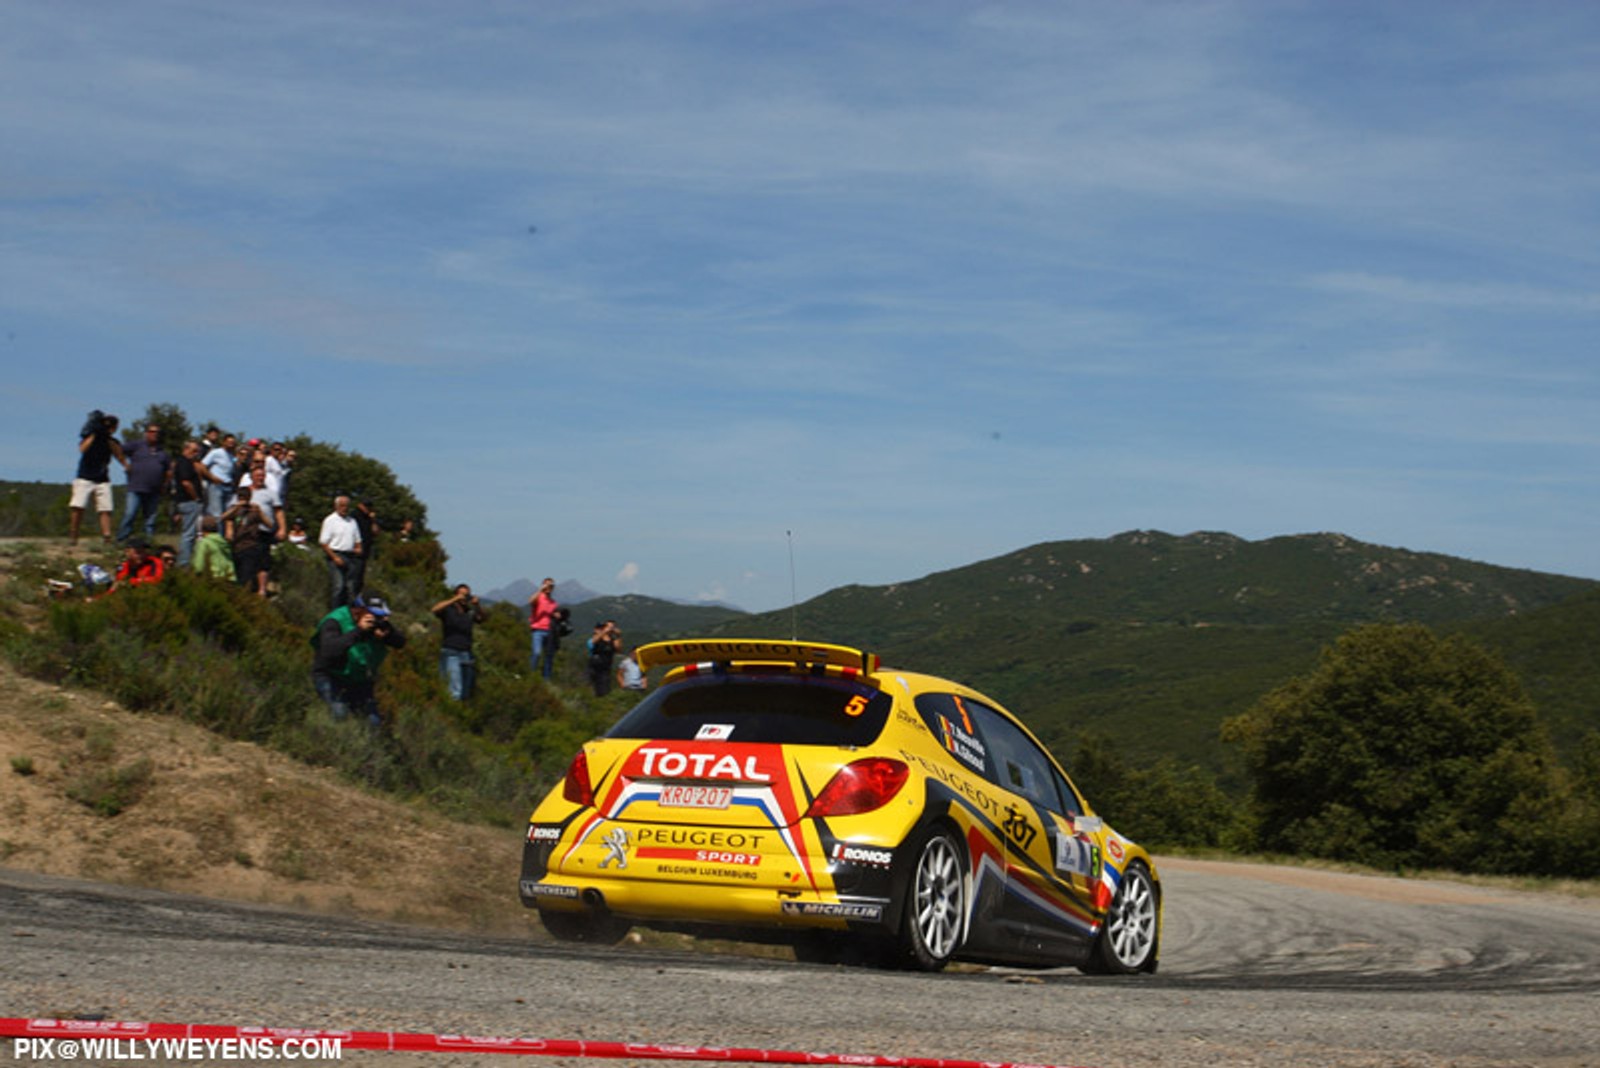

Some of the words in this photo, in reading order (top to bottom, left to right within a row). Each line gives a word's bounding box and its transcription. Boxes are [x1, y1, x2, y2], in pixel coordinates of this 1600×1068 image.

[844, 695, 868, 716] 5
[638, 748, 771, 781] TOTAL
[899, 749, 1000, 817] PEUGEOT
[1003, 804, 1038, 851] 207
[637, 829, 765, 849] PEUGEOT
[695, 850, 760, 865] SPORT
[832, 842, 892, 863] KRONOS
[657, 865, 697, 875] BELGIUM
[700, 867, 757, 880] LUXEMBURG
[804, 903, 879, 918] MICHELIN
